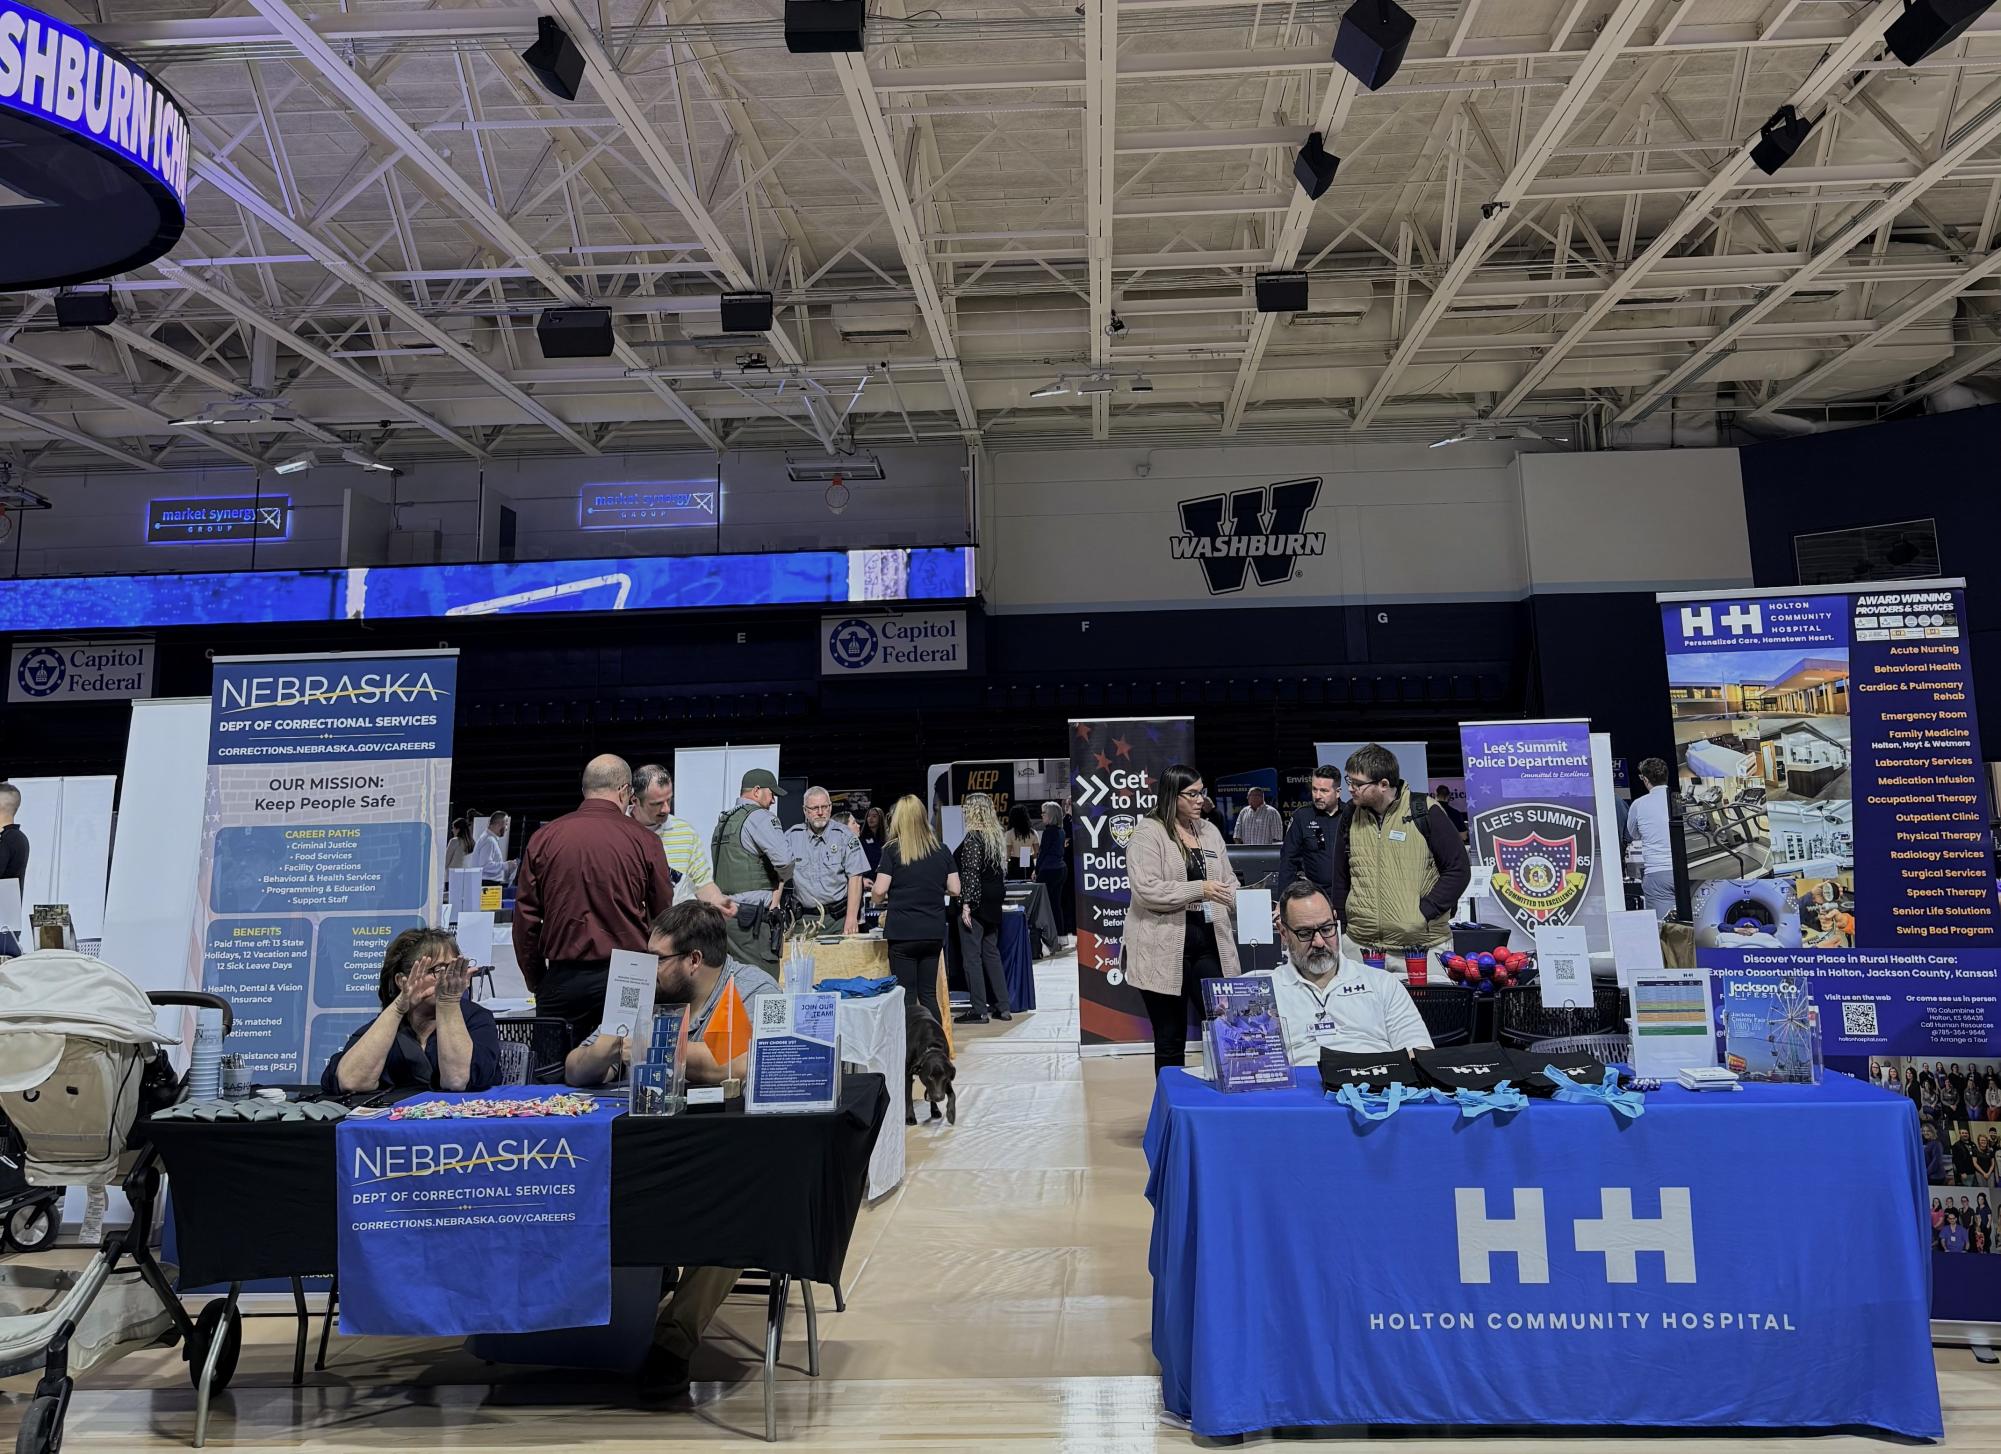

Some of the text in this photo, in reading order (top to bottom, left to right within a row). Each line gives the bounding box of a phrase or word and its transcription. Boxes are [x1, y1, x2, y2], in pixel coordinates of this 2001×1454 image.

[643, 494, 692, 506] synergy
[162, 508, 256, 521] market synergy
[1170, 532, 1326, 559] WASHBURN
[1857, 592, 1952, 605] AWARD WINNING
[1769, 602, 1809, 610] HOLTON
[1855, 603, 1954, 615] PROVIDERS SERVICES
[1377, 612, 1388, 624] G
[1770, 613, 1832, 621] COMMUNITY
[881, 619, 956, 642] Capitol
[1081, 621, 1090, 632] F
[1772, 625, 1821, 633] HOSPITAL
[736, 632, 747, 643] E
[1684, 635, 1807, 647] Personalized Hometown
[882, 644, 957, 664] Federal
[1890, 644, 1960, 655] Acute Nursing
[70, 648, 144, 670] Capitol
[1874, 662, 1961, 673] Behavioral Health
[68, 673, 143, 692] Federal
[1859, 681, 1964, 692] Cardiac Pulmonary
[221, 672, 438, 708] NEBRASKA
[1933, 692, 1966, 701] Rehab
[1881, 710, 1968, 722] Emergency Room
[219, 715, 437, 732] DEPT OF CORRECTIONAL SERVICES
[1889, 728, 1970, 739] Family Medicine
[218, 742, 436, 756] CORRECTIONS.NEBRASKA.GOV/CAREERS
[1483, 740, 1568, 754] Lee's Summit
[1467, 755, 1588, 769] Police Department
[1875, 757, 1973, 768] Laboratory Services
[269, 776, 385, 791] OUR MISSION:
[967, 770, 999, 790] KEEP
[1109, 769, 1149, 789] Get
[1878, 774, 1976, 785] Medication Infusion
[255, 794, 396, 813] Keep People Safe
[1110, 791, 1130, 809] to
[1867, 794, 1977, 805] Occupational Therapy
[1481, 809, 1587, 833] LEE'S SUMMIT
[1895, 812, 1980, 823] Outpatient Clinic
[285, 829, 361, 839] CAREER PATHS
[1896, 831, 1982, 842] Physical Therapy
[291, 840, 358, 850] Criminal Justice
[295, 851, 353, 861] Food Services
[1890, 849, 1985, 861] Radiology Services
[1083, 852, 1126, 871] Polic
[1483, 856, 1496, 867] 18
[1577, 856, 1591, 866] 65
[284, 862, 361, 873] Facility Operations
[263, 872, 381, 883] Behavioral Health Services
[1901, 868, 1987, 879] Surgical Services
[266, 883, 376, 895] Programming Education
[1906, 888, 1987, 898] Speech Therapy
[292, 895, 348, 905] Support Staff
[1504, 887, 1537, 907] COMMITTED
[1545, 887, 1576, 907] EXCELLENCE
[1102, 908, 1123, 917] Meet
[1892, 906, 1992, 915] Senior Life Solutions
[233, 927, 282, 936] BENEFITS
[352, 926, 392, 936] VALUES
[1896, 925, 1994, 937] Swing Program
[214, 938, 304, 948] Paid Time State
[353, 938, 389, 949] Integrity
[1104, 937, 1118, 945] Ask
[253, 950, 290, 959] Vacation
[1743, 954, 1958, 964] Discover Your Place Rural Health Care:
[246, 961, 274, 970] Leave
[1745, 967, 1815, 977] Opportunities
[1827, 968, 1865, 978] Holton,
[1866, 968, 1910, 978] Jackson
[1911, 969, 1954, 980] County,
[1955, 969, 1998, 978] Kansas!
[238, 983, 303, 993] Dental Vision
[1728, 981, 1778, 997] Jackson
[1779, 982, 1800, 993] Co.
[231, 995, 273, 1004] Insurance
[244, 1017, 283, 1026] matched
[354, 1137, 577, 1179] NEBRASKA
[352, 1184, 576, 1204] DEPT OF CORRECTIONAL SERVICES
[352, 1212, 576, 1231] CORRECTIONS.NEBRASKA.GOV/CAREERS
[1369, 1312, 1797, 1331] HOLTON COMMUNITY HOSPITAL
